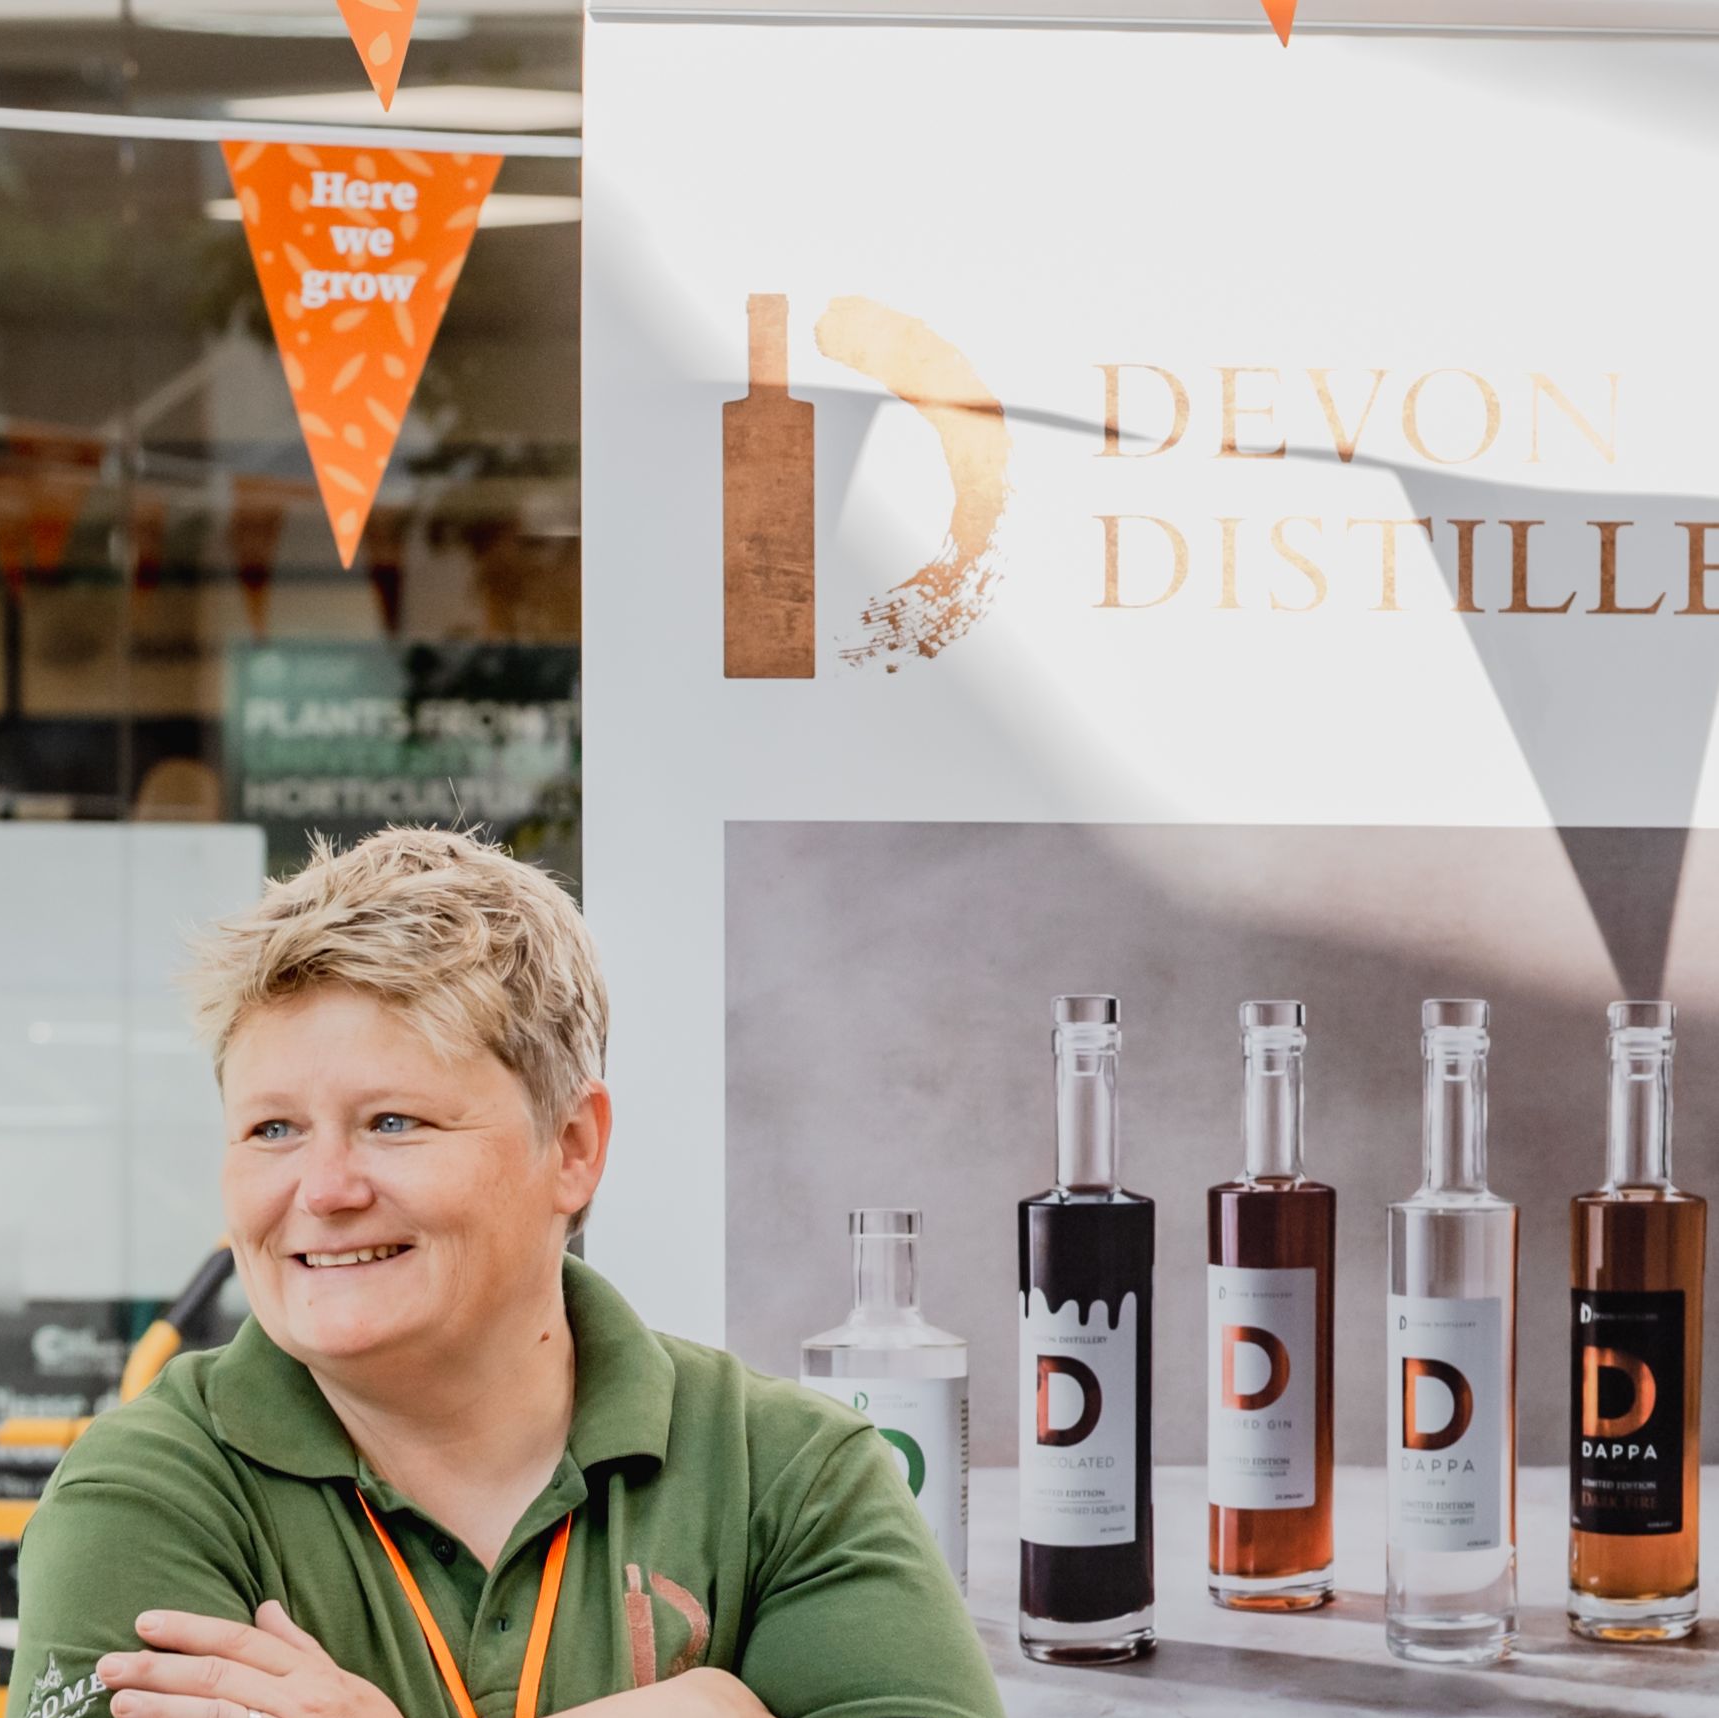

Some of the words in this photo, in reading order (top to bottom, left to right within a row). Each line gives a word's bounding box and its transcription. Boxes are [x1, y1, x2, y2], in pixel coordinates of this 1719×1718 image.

[309, 171, 418, 211] Here
[330, 225, 394, 257] we
[300, 269, 417, 309] grow
[1092, 364, 1624, 465] DEVON
[1221, 1325, 1291, 1411] D
[1036, 1355, 1103, 1447] D
[1402, 1357, 1474, 1451] D
[1583, 1345, 1657, 1438] D
[1267, 1419, 1292, 1430] GIN
[1401, 1458, 1475, 1473] DAPPA
[1582, 1441, 1658, 1460] DAPPA
